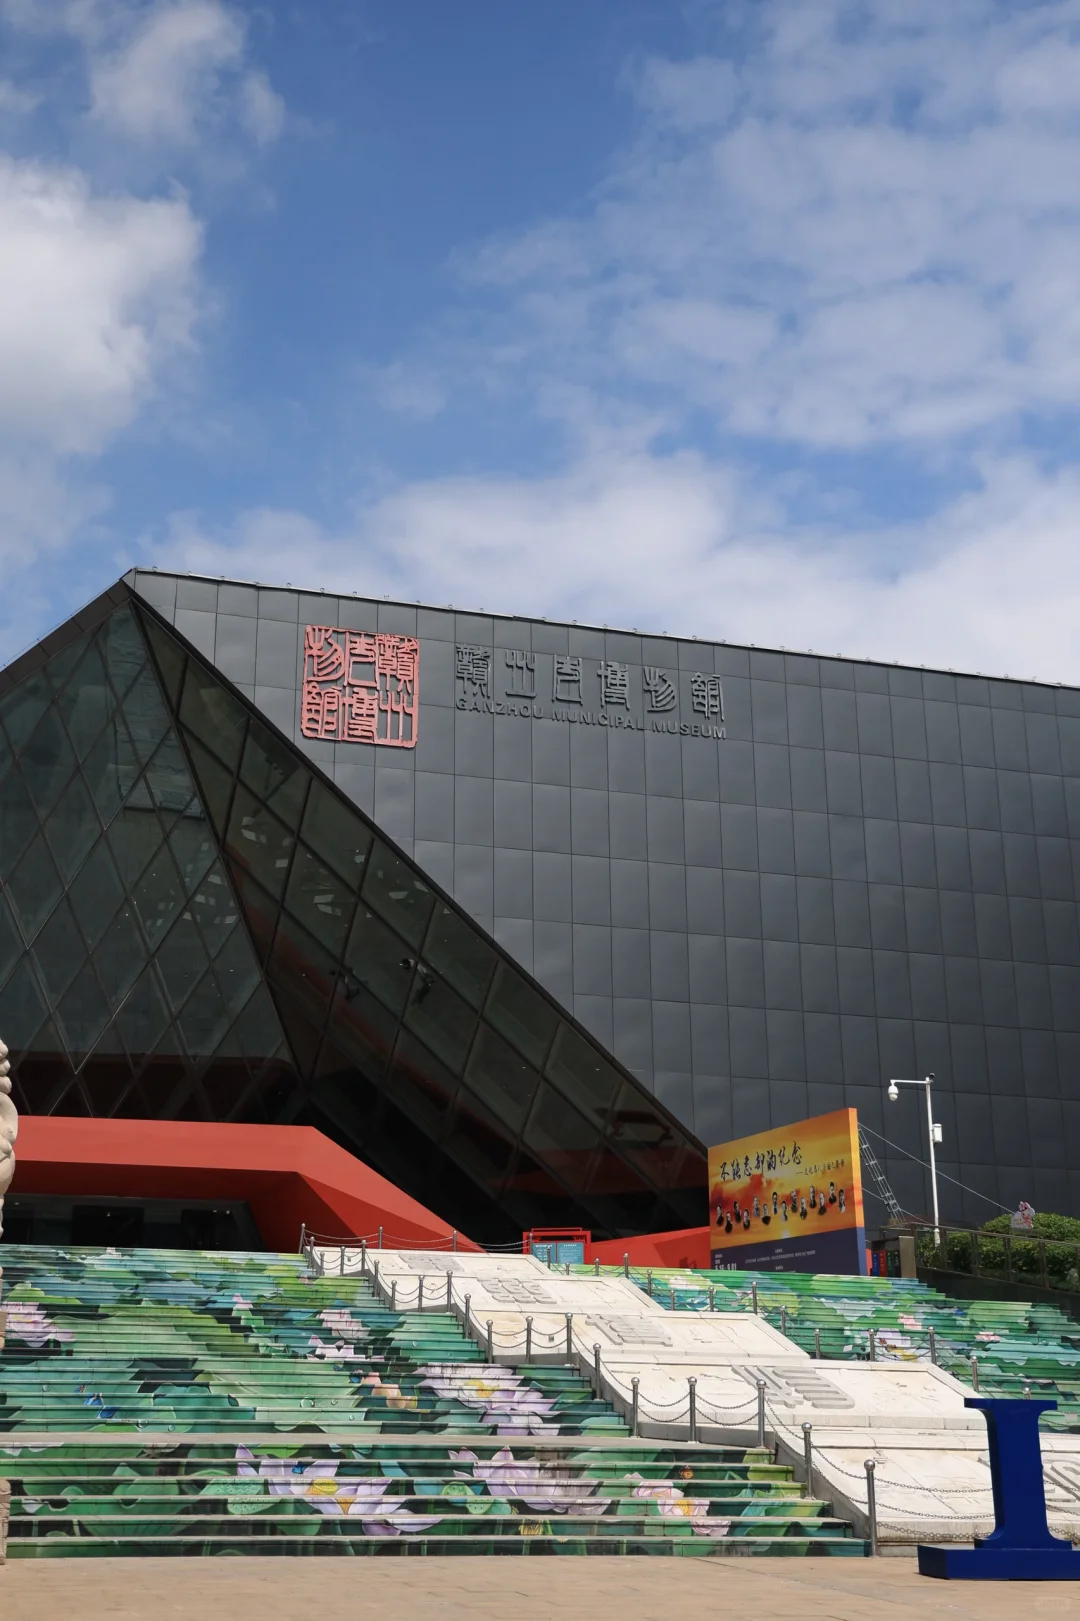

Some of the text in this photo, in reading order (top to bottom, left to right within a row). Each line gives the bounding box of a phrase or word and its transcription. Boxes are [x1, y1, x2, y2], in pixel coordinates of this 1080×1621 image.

[455, 698, 727, 740] GANZHOU MUNICIPAL MUSEUM
